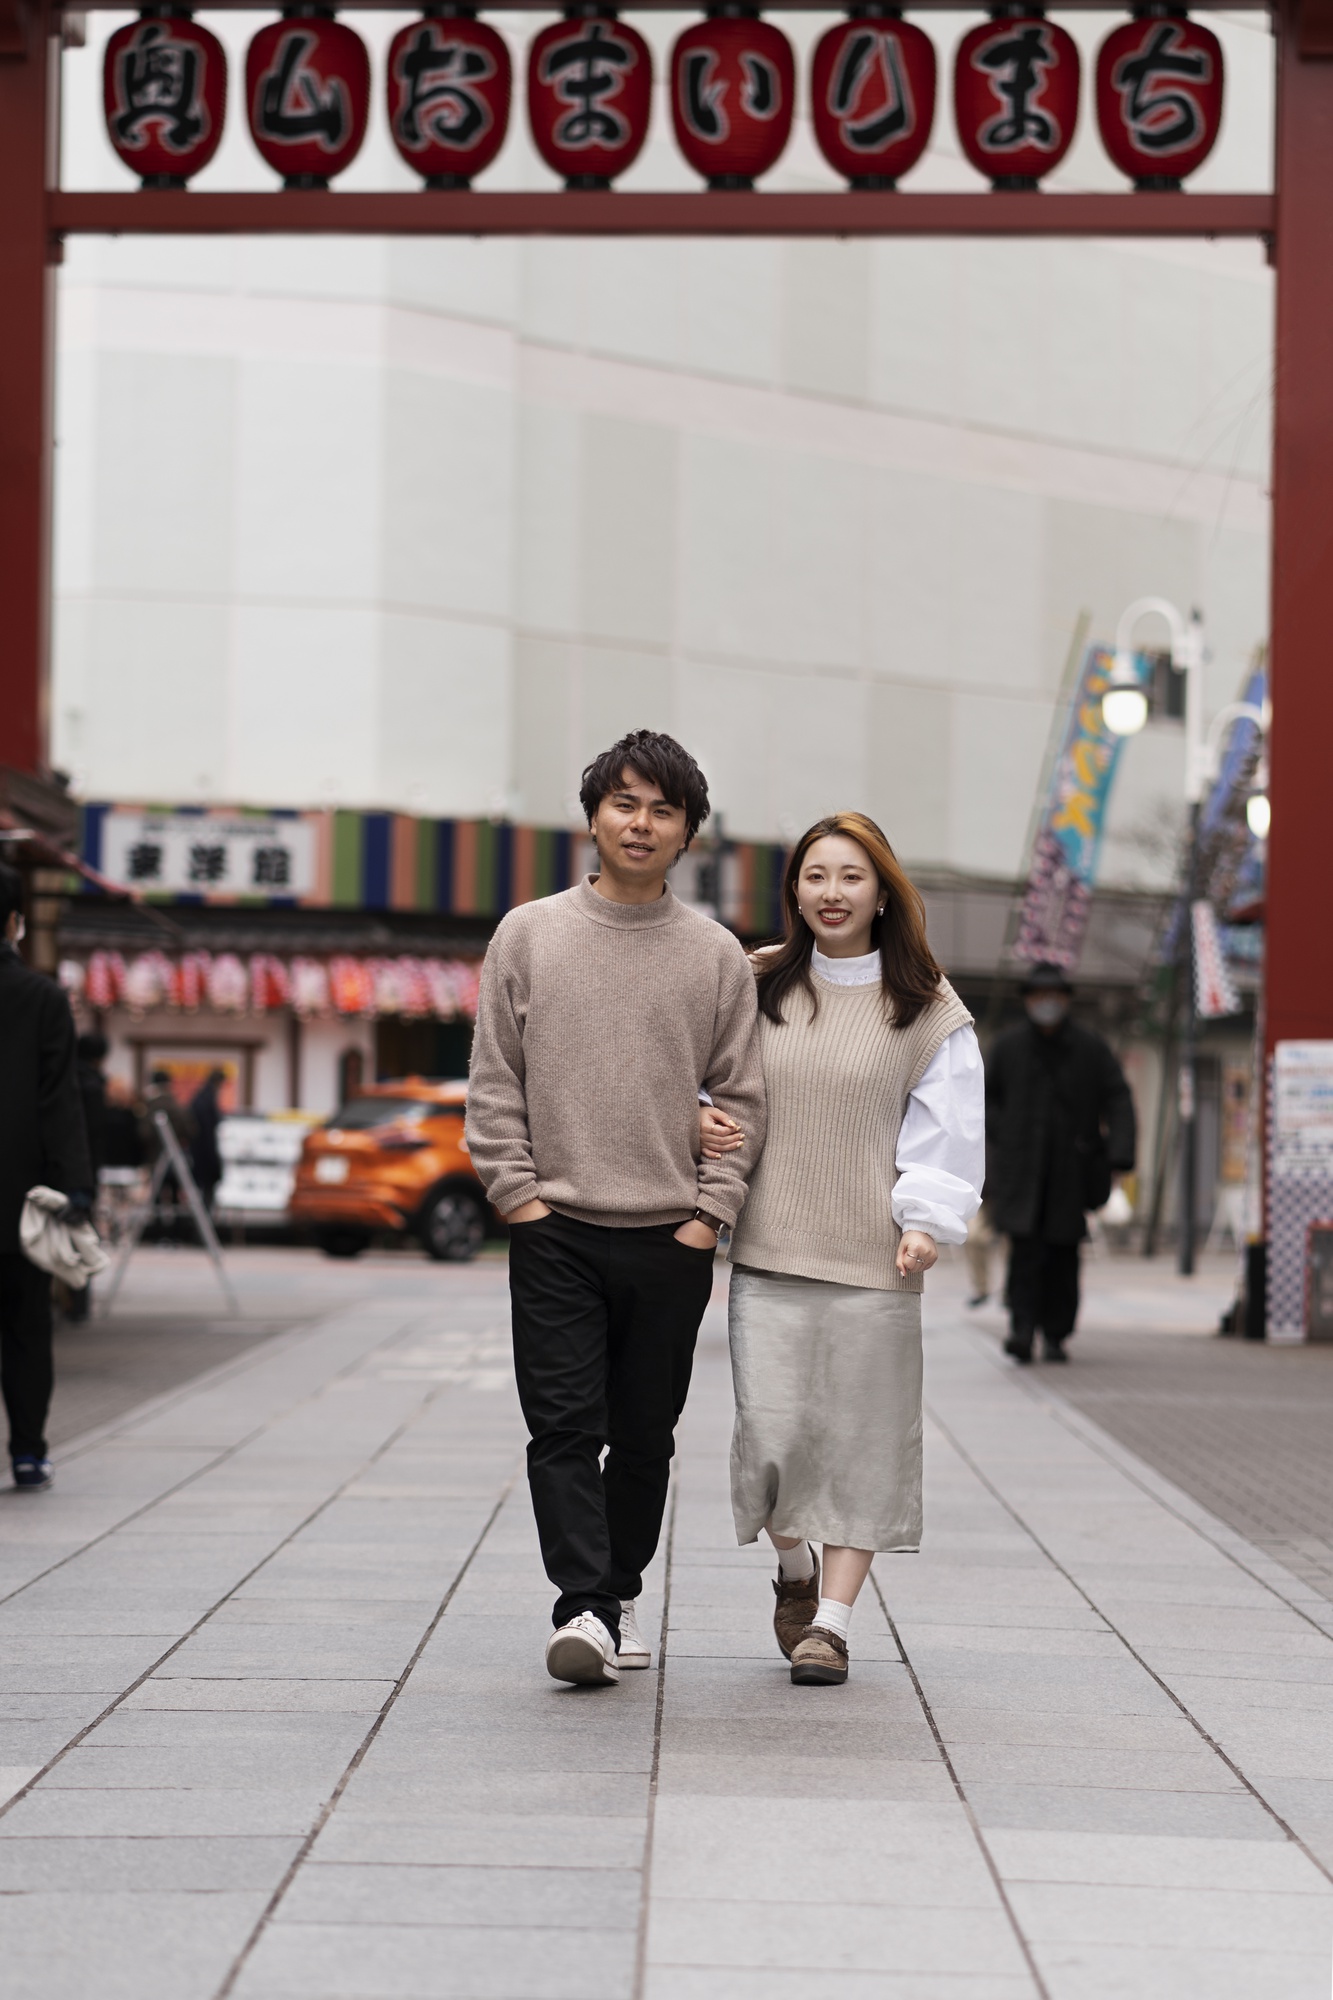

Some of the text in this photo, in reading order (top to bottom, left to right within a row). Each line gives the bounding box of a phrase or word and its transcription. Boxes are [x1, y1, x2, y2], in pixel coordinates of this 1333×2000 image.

[110, 22, 1208, 155] 奥山おまいりまち
